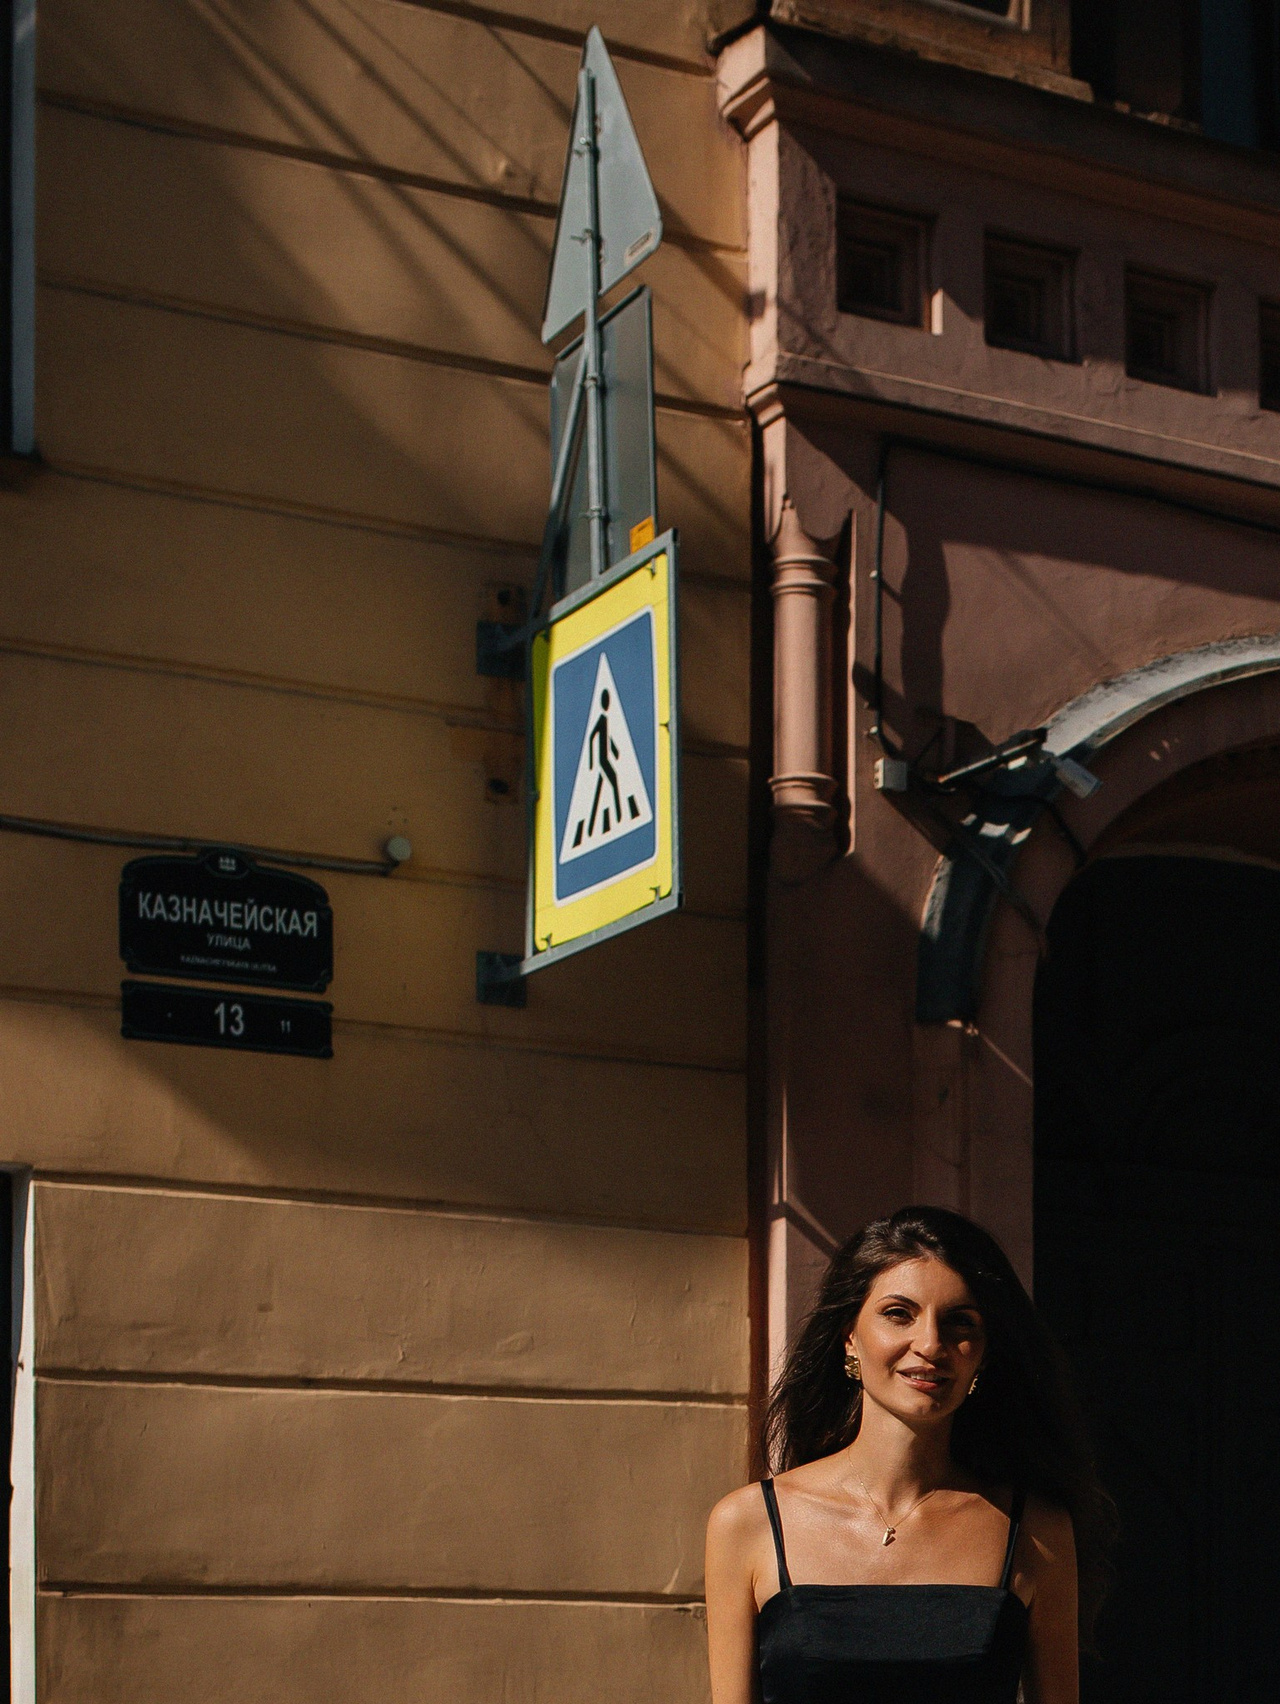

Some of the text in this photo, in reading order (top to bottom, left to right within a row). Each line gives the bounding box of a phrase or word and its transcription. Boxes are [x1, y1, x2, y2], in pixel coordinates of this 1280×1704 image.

[138, 891, 318, 938] КАЗНАЧЕЙСКАЯ
[207, 933, 251, 951] УЛИЦА
[214, 1002, 244, 1036] 13
